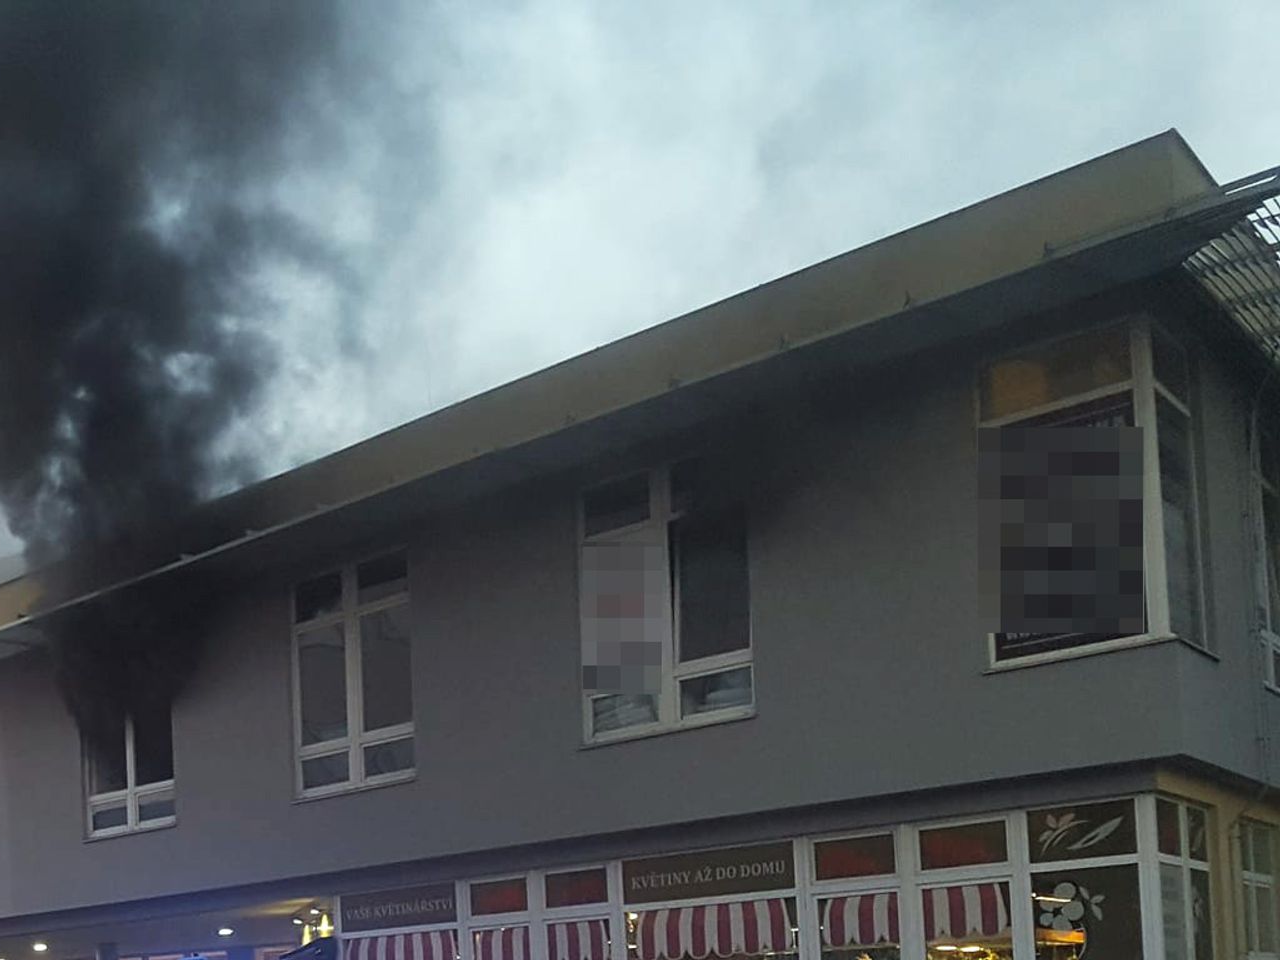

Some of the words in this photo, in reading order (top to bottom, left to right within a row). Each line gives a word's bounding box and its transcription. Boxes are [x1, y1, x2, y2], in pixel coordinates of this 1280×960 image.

[631, 870, 691, 890] KVĚTINY
[694, 865, 713, 883] AŽ
[715, 865, 737, 881] DO
[740, 859, 786, 878] DOMU
